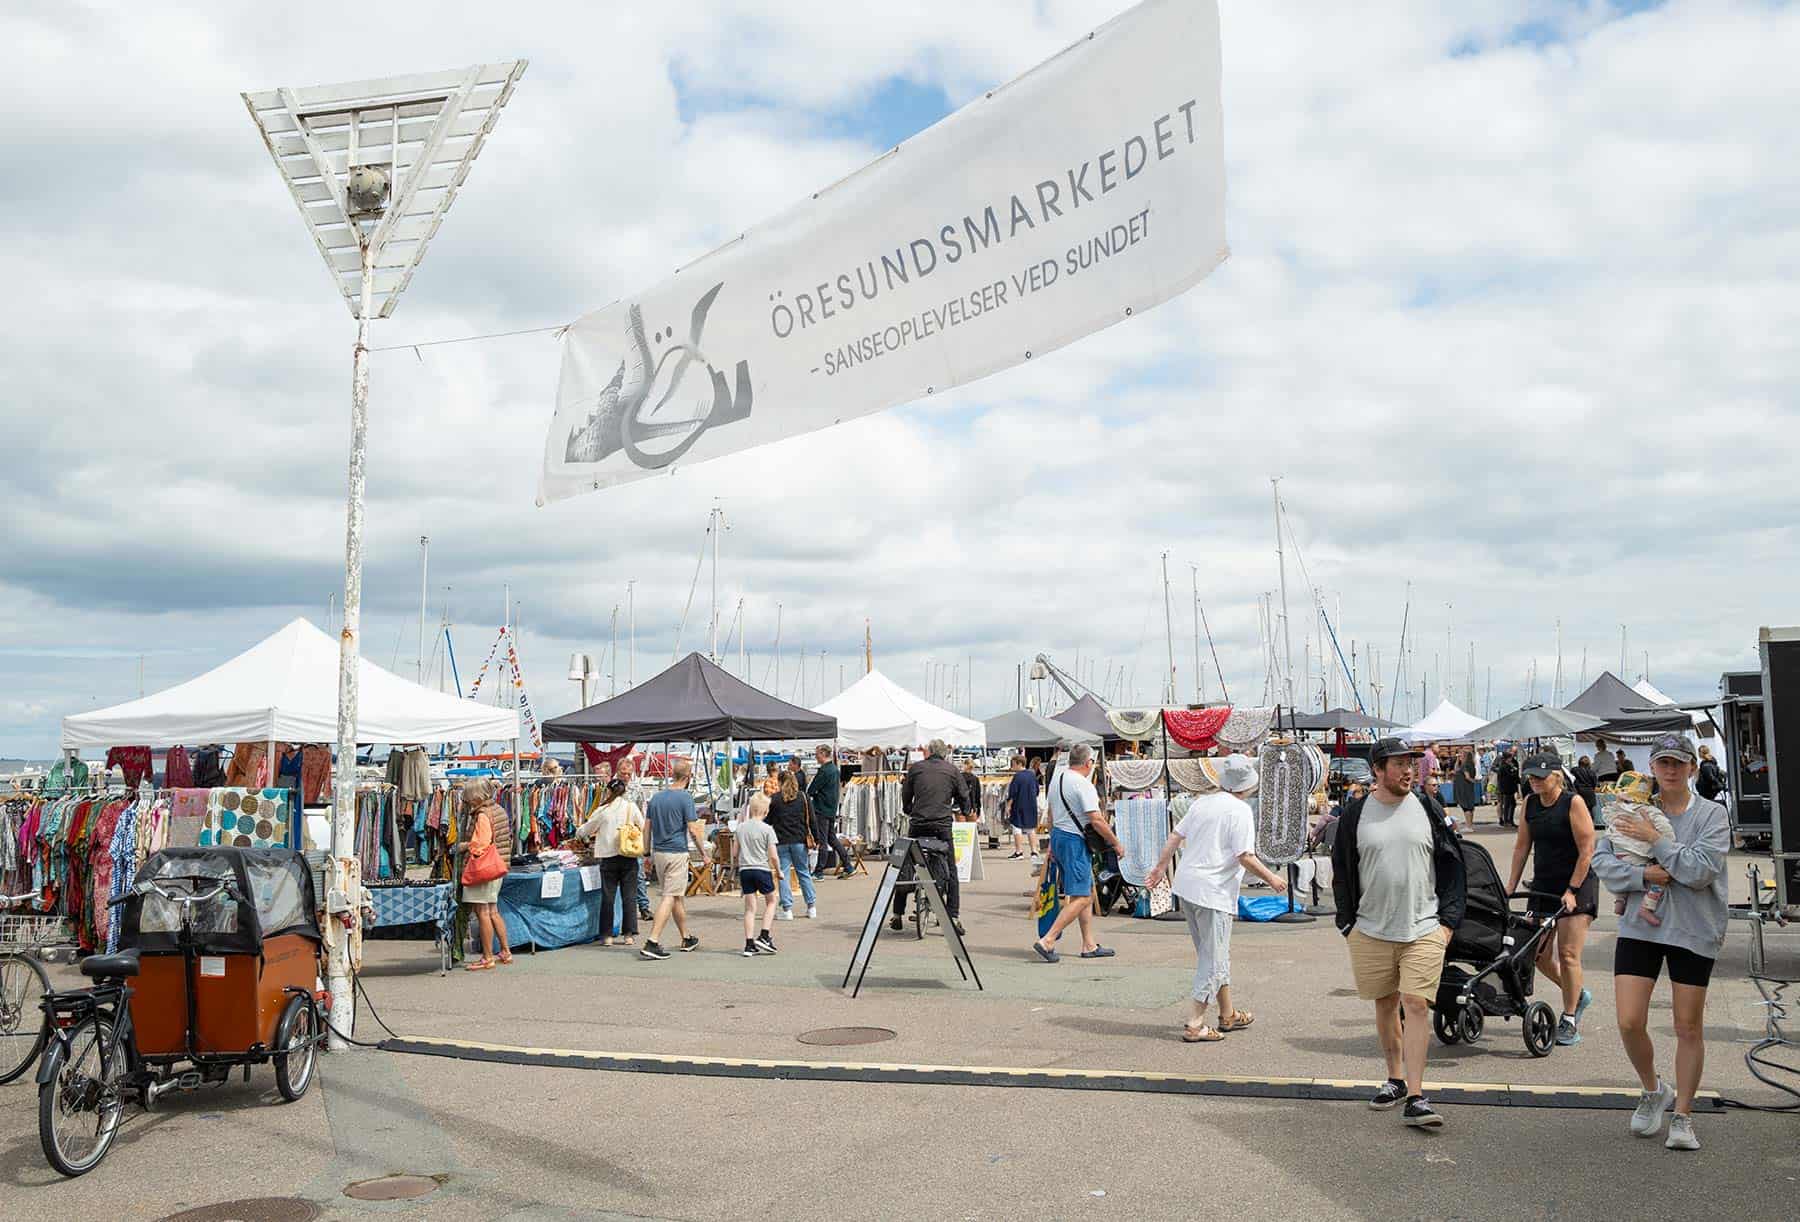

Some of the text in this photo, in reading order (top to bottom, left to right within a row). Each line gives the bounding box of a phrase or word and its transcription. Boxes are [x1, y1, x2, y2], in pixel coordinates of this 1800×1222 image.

[769, 99, 1198, 339] ÖRESUNDSMARKEDET
[824, 280, 1009, 377] SANSEOPLEVELSER
[1011, 258, 1059, 297] VED
[1065, 207, 1150, 276] SUNDET
